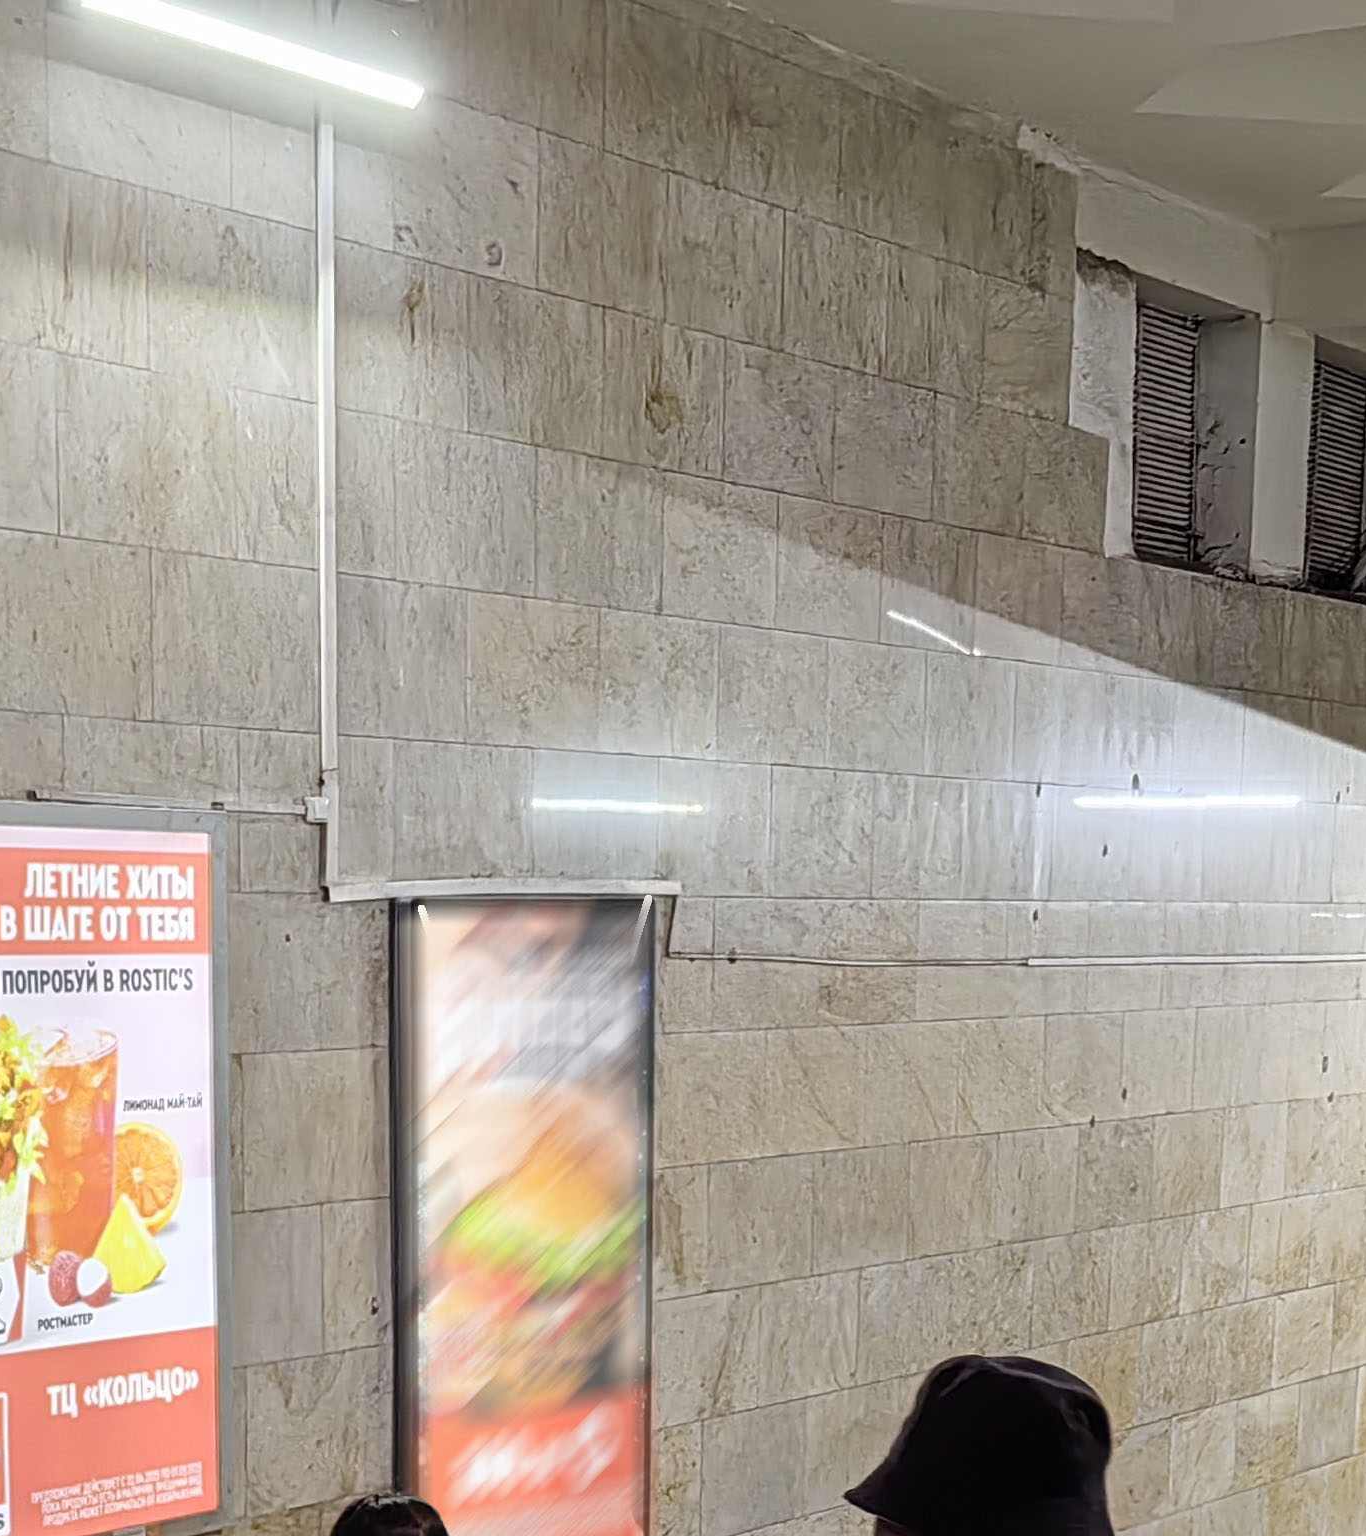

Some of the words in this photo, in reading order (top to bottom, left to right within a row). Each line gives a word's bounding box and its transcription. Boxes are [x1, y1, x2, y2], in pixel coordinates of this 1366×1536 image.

[24, 862, 120, 899] ЛЕТНИЕ
[125, 865, 194, 900] ХИТЫ
[0, 905, 17, 941] В
[24, 905, 94, 941] ШАГЕ
[100, 905, 131, 941] ОТ
[136, 906, 195, 941] ТЕБЯ
[2, 960, 97, 994] ПОПРОБУЙ
[103, 970, 114, 993] В
[119, 968, 193, 992] ROSTIC'S
[123, 1098, 165, 1112] ЛИМОНАД
[37, 1312, 94, 1331] РОСТМАСТЕР
[46, 1383, 78, 1417] ТЦ
[83, 1366, 199, 1408] «КОЛЬЦО»
